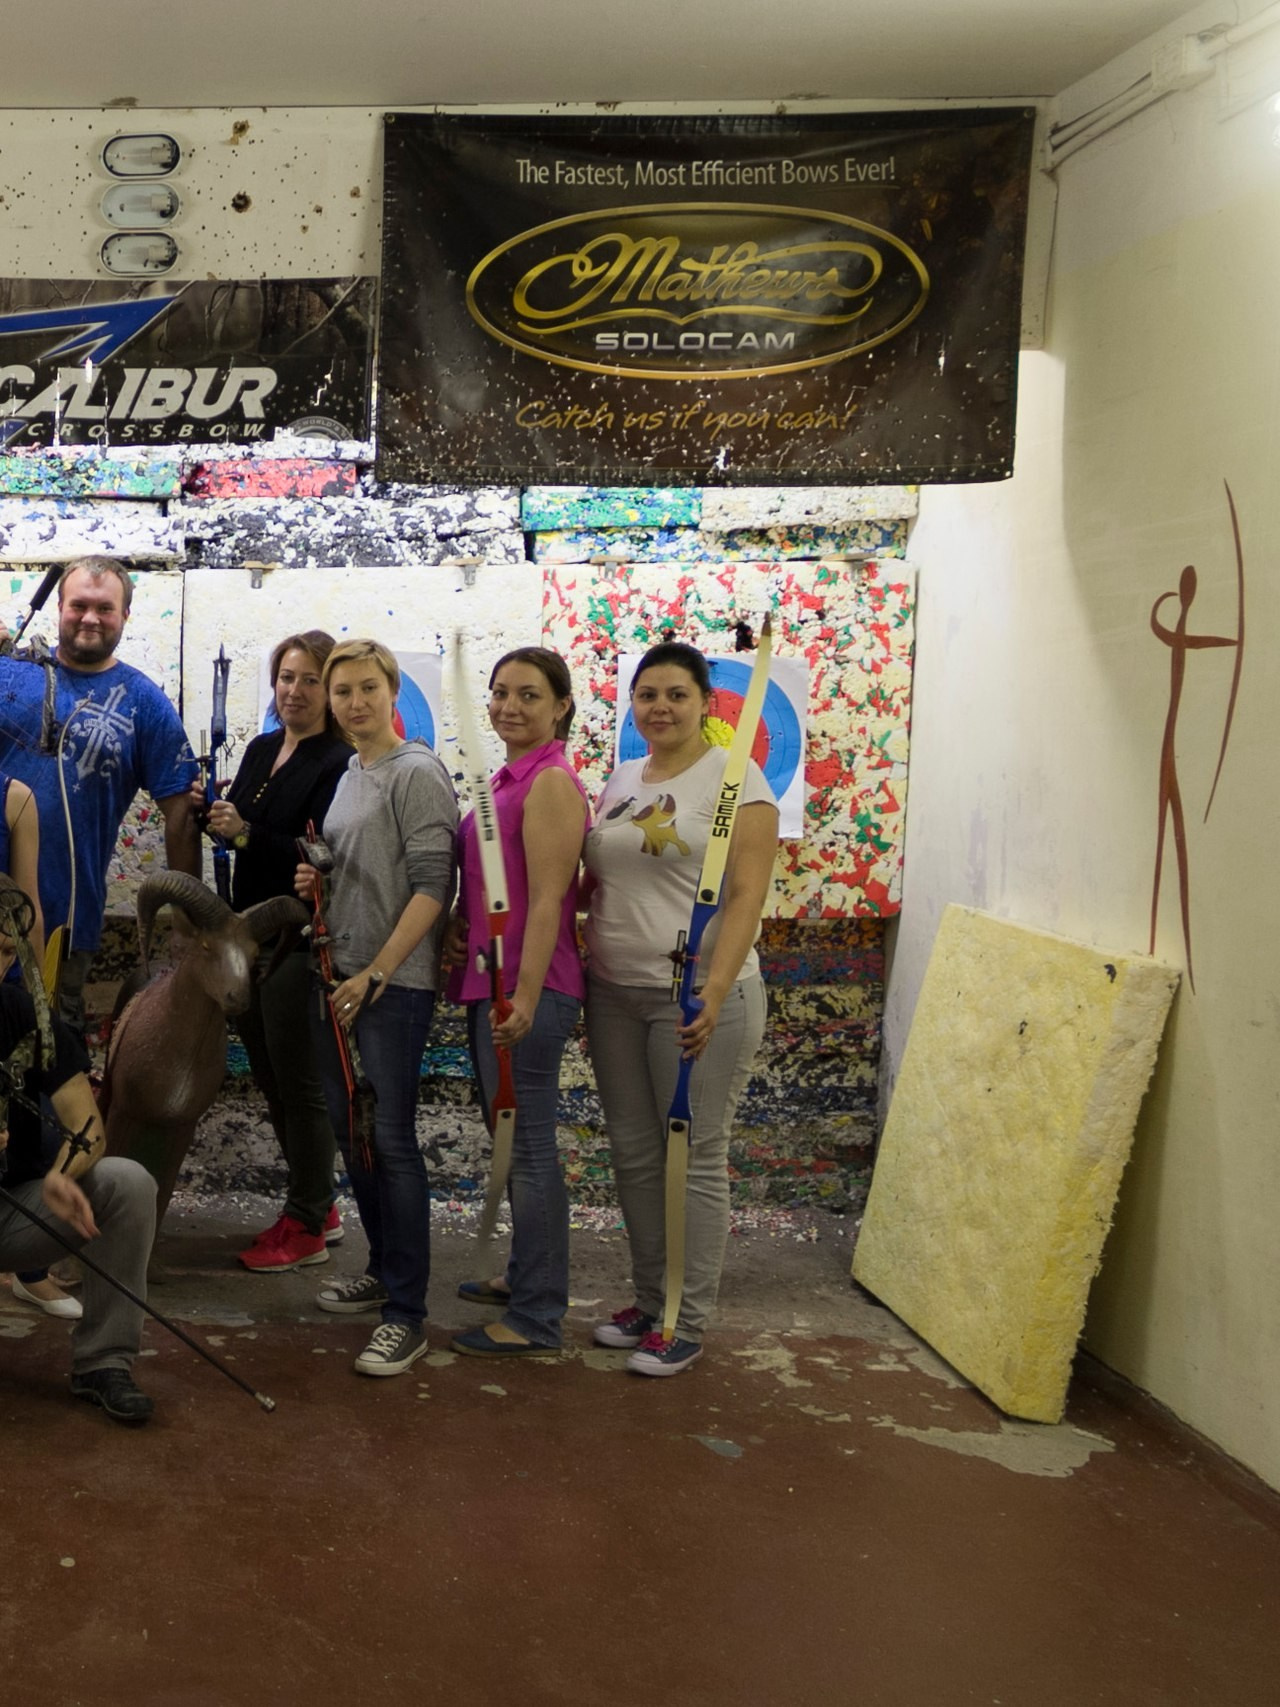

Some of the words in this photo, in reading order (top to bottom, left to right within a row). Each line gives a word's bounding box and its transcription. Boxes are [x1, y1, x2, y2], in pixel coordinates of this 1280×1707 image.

[516, 159, 549, 183] The
[555, 160, 629, 189] Fastest,
[635, 161, 686, 186] Most
[691, 160, 776, 186] Efficient
[782, 160, 839, 184] Bows
[845, 156, 895, 182] Ever!
[513, 233, 882, 320] Mathews
[595, 332, 795, 350] SOLOCAM
[27, 423, 267, 439] CROSSBOW
[515, 401, 613, 429] Catch
[624, 411, 667, 430] us
[673, 401, 706, 430] if
[703, 412, 769, 441] you
[777, 405, 859, 430] can!
[712, 782, 740, 838] SAMICK
